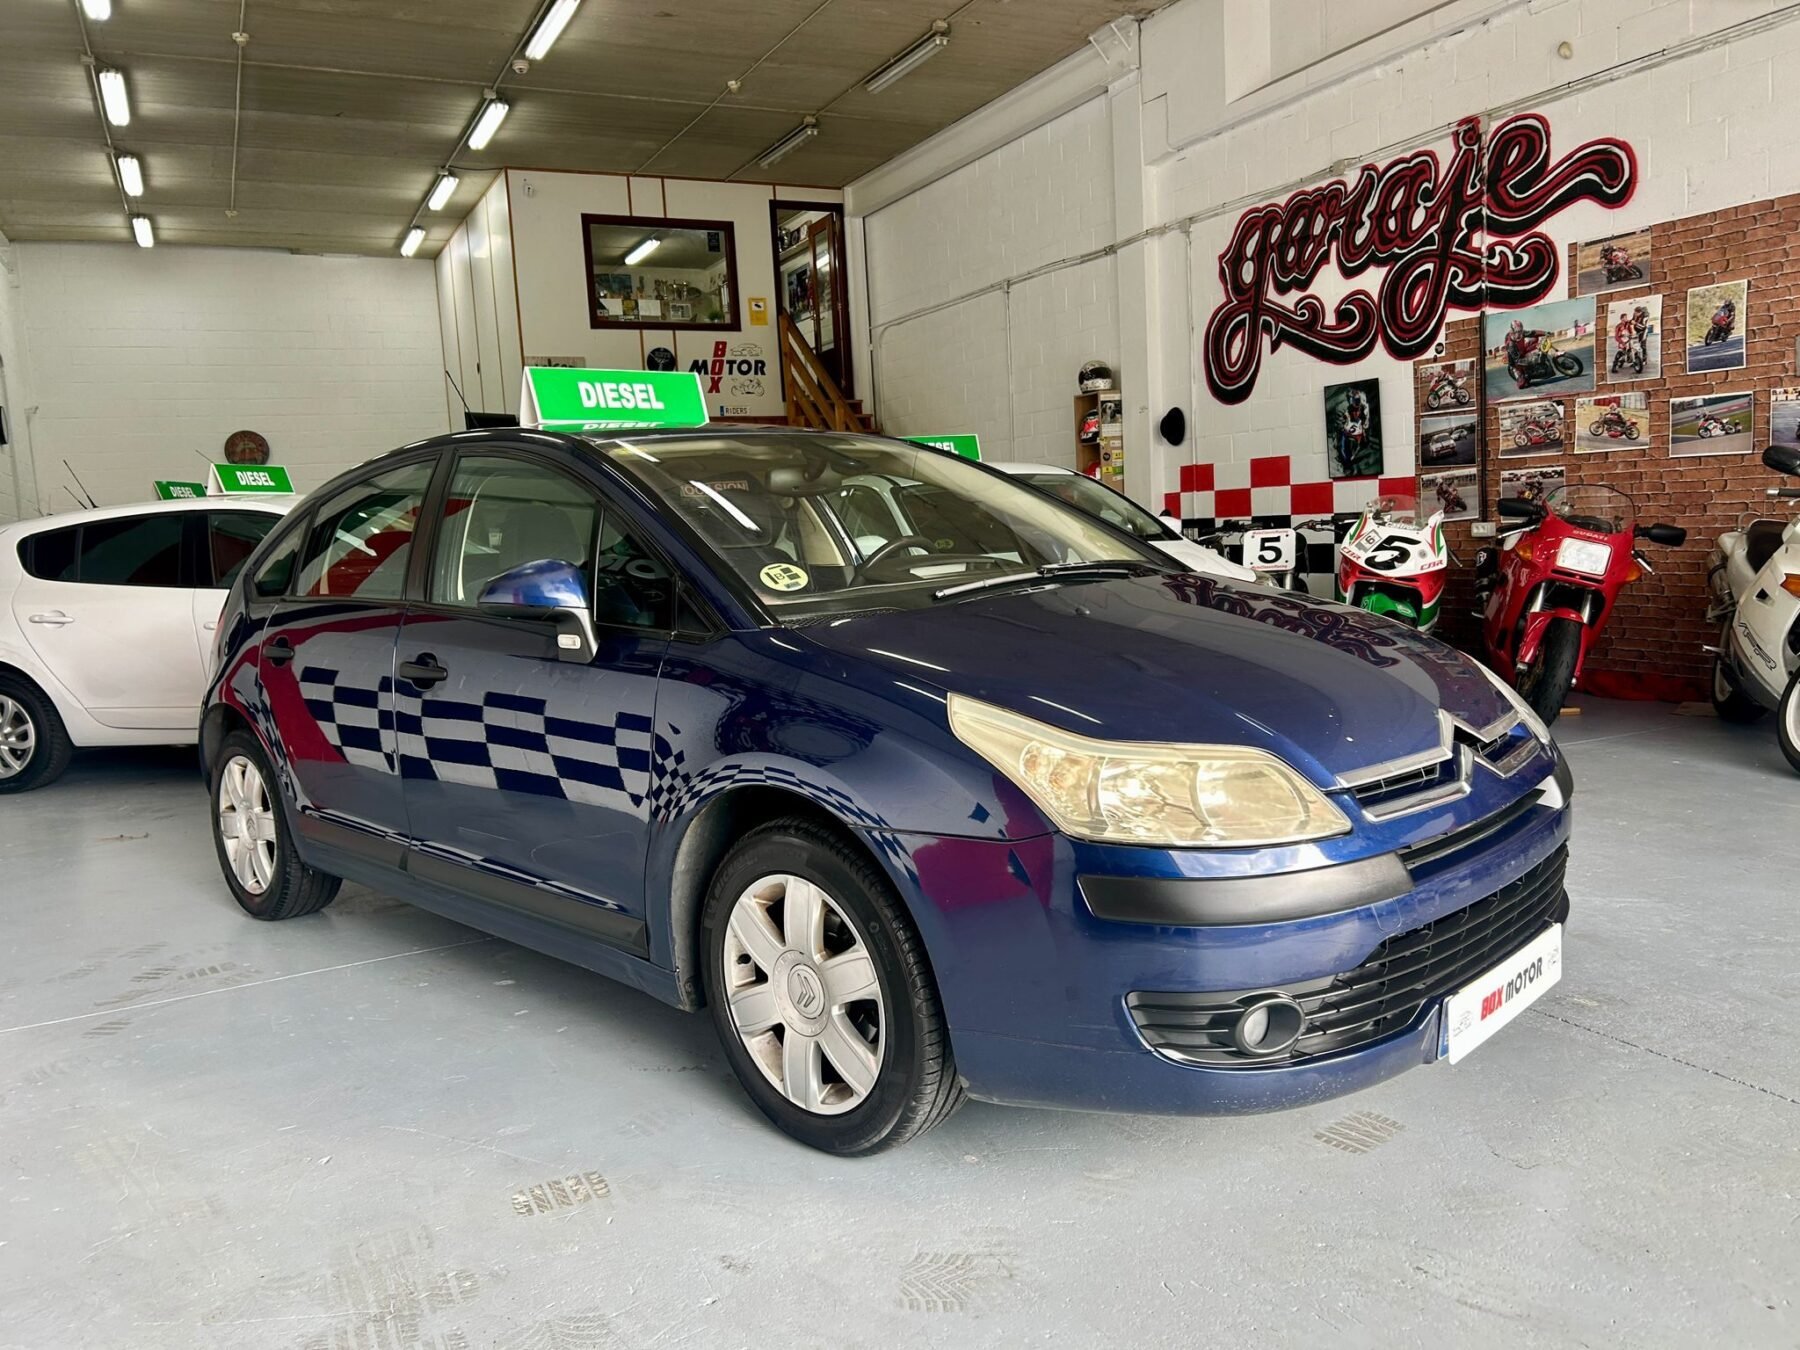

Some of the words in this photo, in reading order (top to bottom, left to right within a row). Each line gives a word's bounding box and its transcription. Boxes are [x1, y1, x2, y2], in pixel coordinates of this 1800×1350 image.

[1205, 113, 1637, 405] garaje
[707, 341, 727, 393] BOX
[578, 381, 665, 410] DIESEL
[725, 407, 748, 415] RIDERS
[235, 470, 276, 487] DIESEL
[169, 486, 197, 498] DIESEL
[1572, 529, 1609, 541] DUCATI
[1258, 535, 1283, 564] 5
[1341, 546, 1361, 561] CBR
[1364, 535, 1422, 571] 5
[1420, 559, 1444, 571] CBR
[1480, 984, 1504, 1021] BOX
[1505, 956, 1543, 1003] MOTOR
